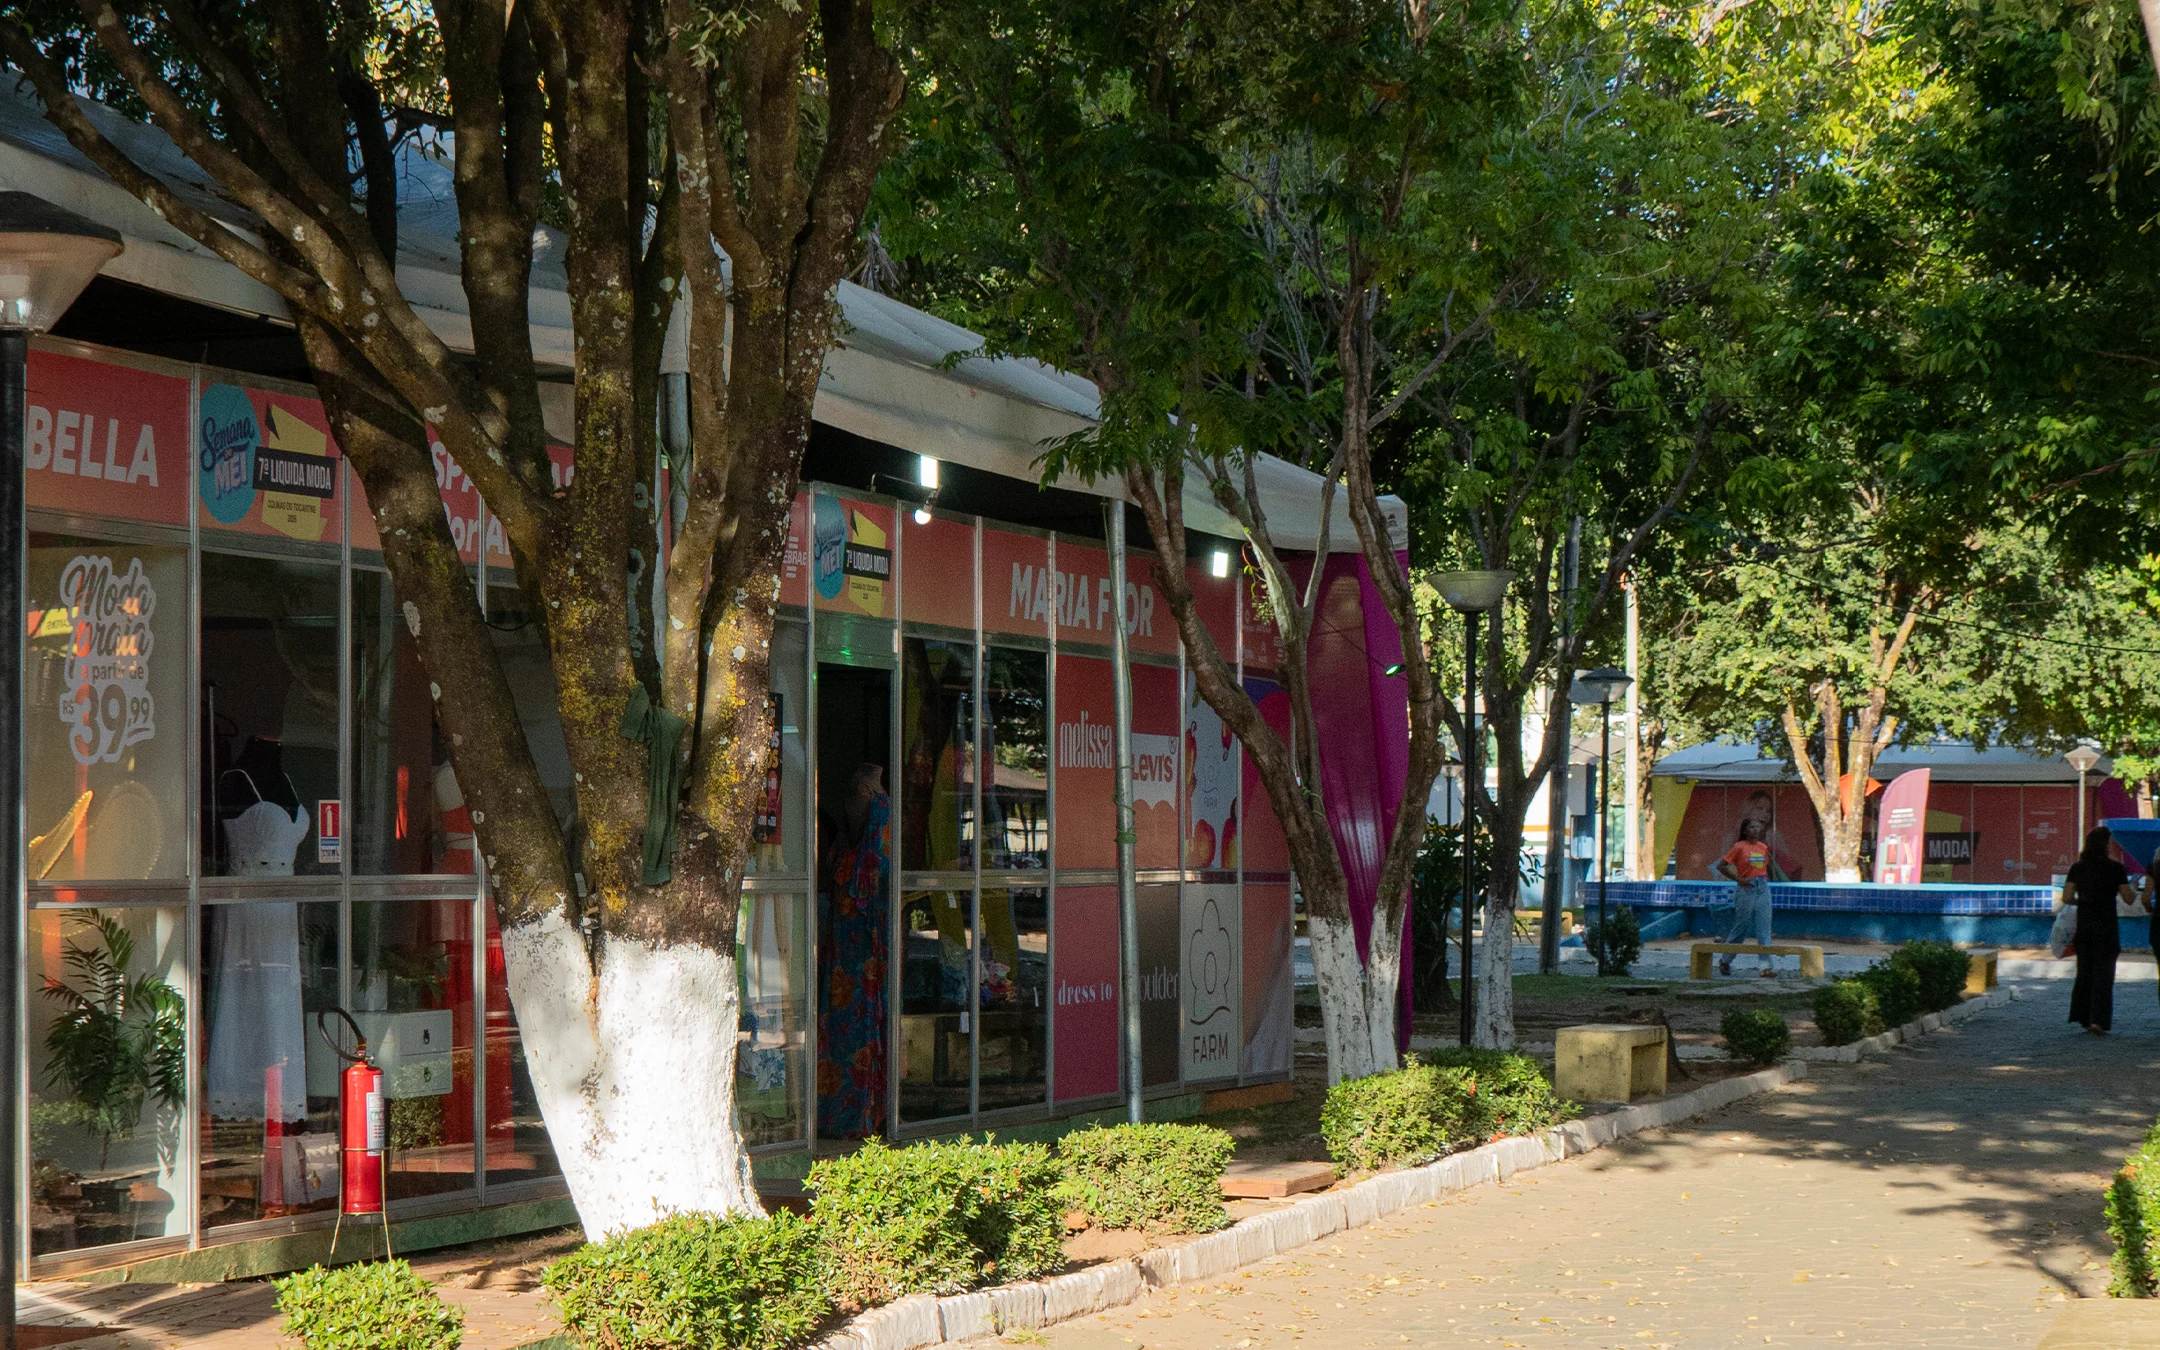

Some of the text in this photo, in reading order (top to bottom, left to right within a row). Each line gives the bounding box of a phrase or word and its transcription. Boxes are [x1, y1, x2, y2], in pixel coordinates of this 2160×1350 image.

[27, 404, 158, 487] BELLA
[200, 416, 255, 472] Semana
[214, 452, 248, 499] MEI
[270, 459, 305, 486] LIQUIDA
[306, 464, 332, 490] MODA
[782, 550, 807, 566] EBRAE
[852, 551, 873, 573] LIQUIDA
[873, 555, 889, 575] MODA
[64, 563, 152, 617] Moda
[1010, 562, 1154, 638] MARIA FOR
[69, 617, 151, 679] praia
[1060, 710, 1112, 769] melissa
[1929, 840, 1970, 858] MODA
[1058, 979, 1113, 1006] dress to
[1140, 965, 1178, 1000] oulder
[1192, 1032, 1228, 1064] FARM
